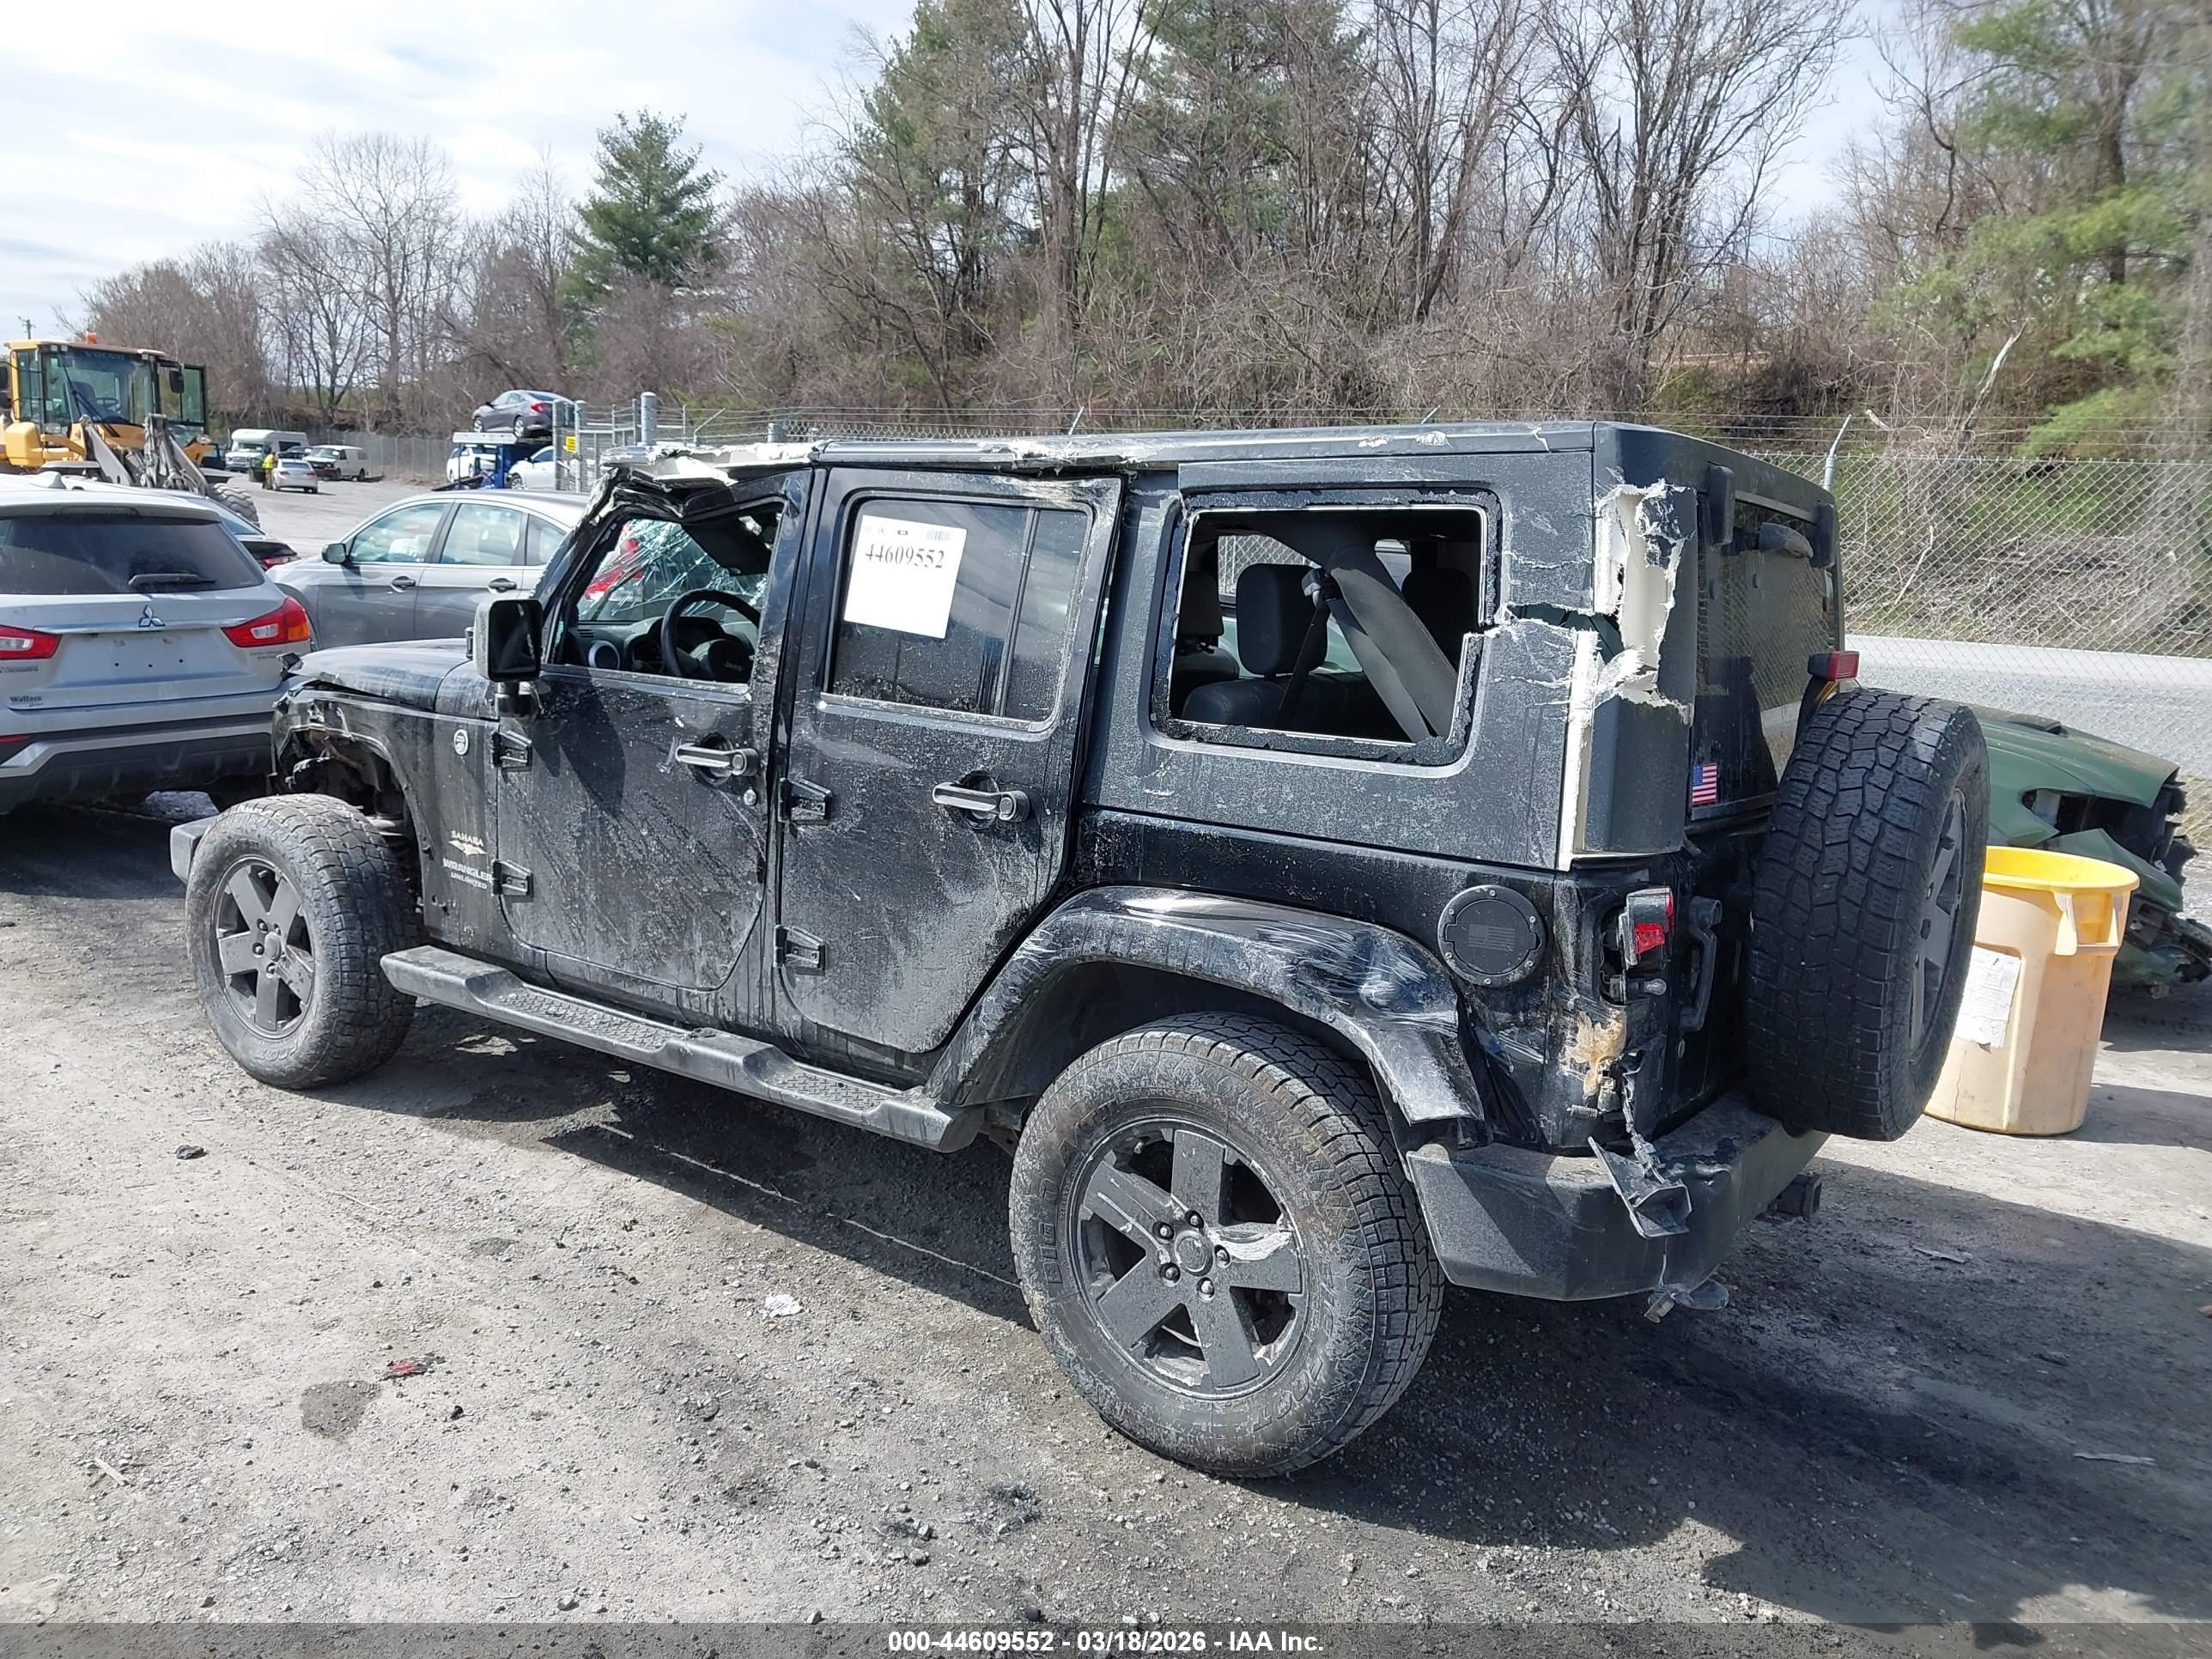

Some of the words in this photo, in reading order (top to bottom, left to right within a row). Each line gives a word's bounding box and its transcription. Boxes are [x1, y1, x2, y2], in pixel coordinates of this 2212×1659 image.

[866, 544, 945, 568] 44609552
[451, 830, 484, 848] SAHARA
[443, 857, 493, 884] WRANGLER
[451, 871, 488, 890] UNLIMITED
